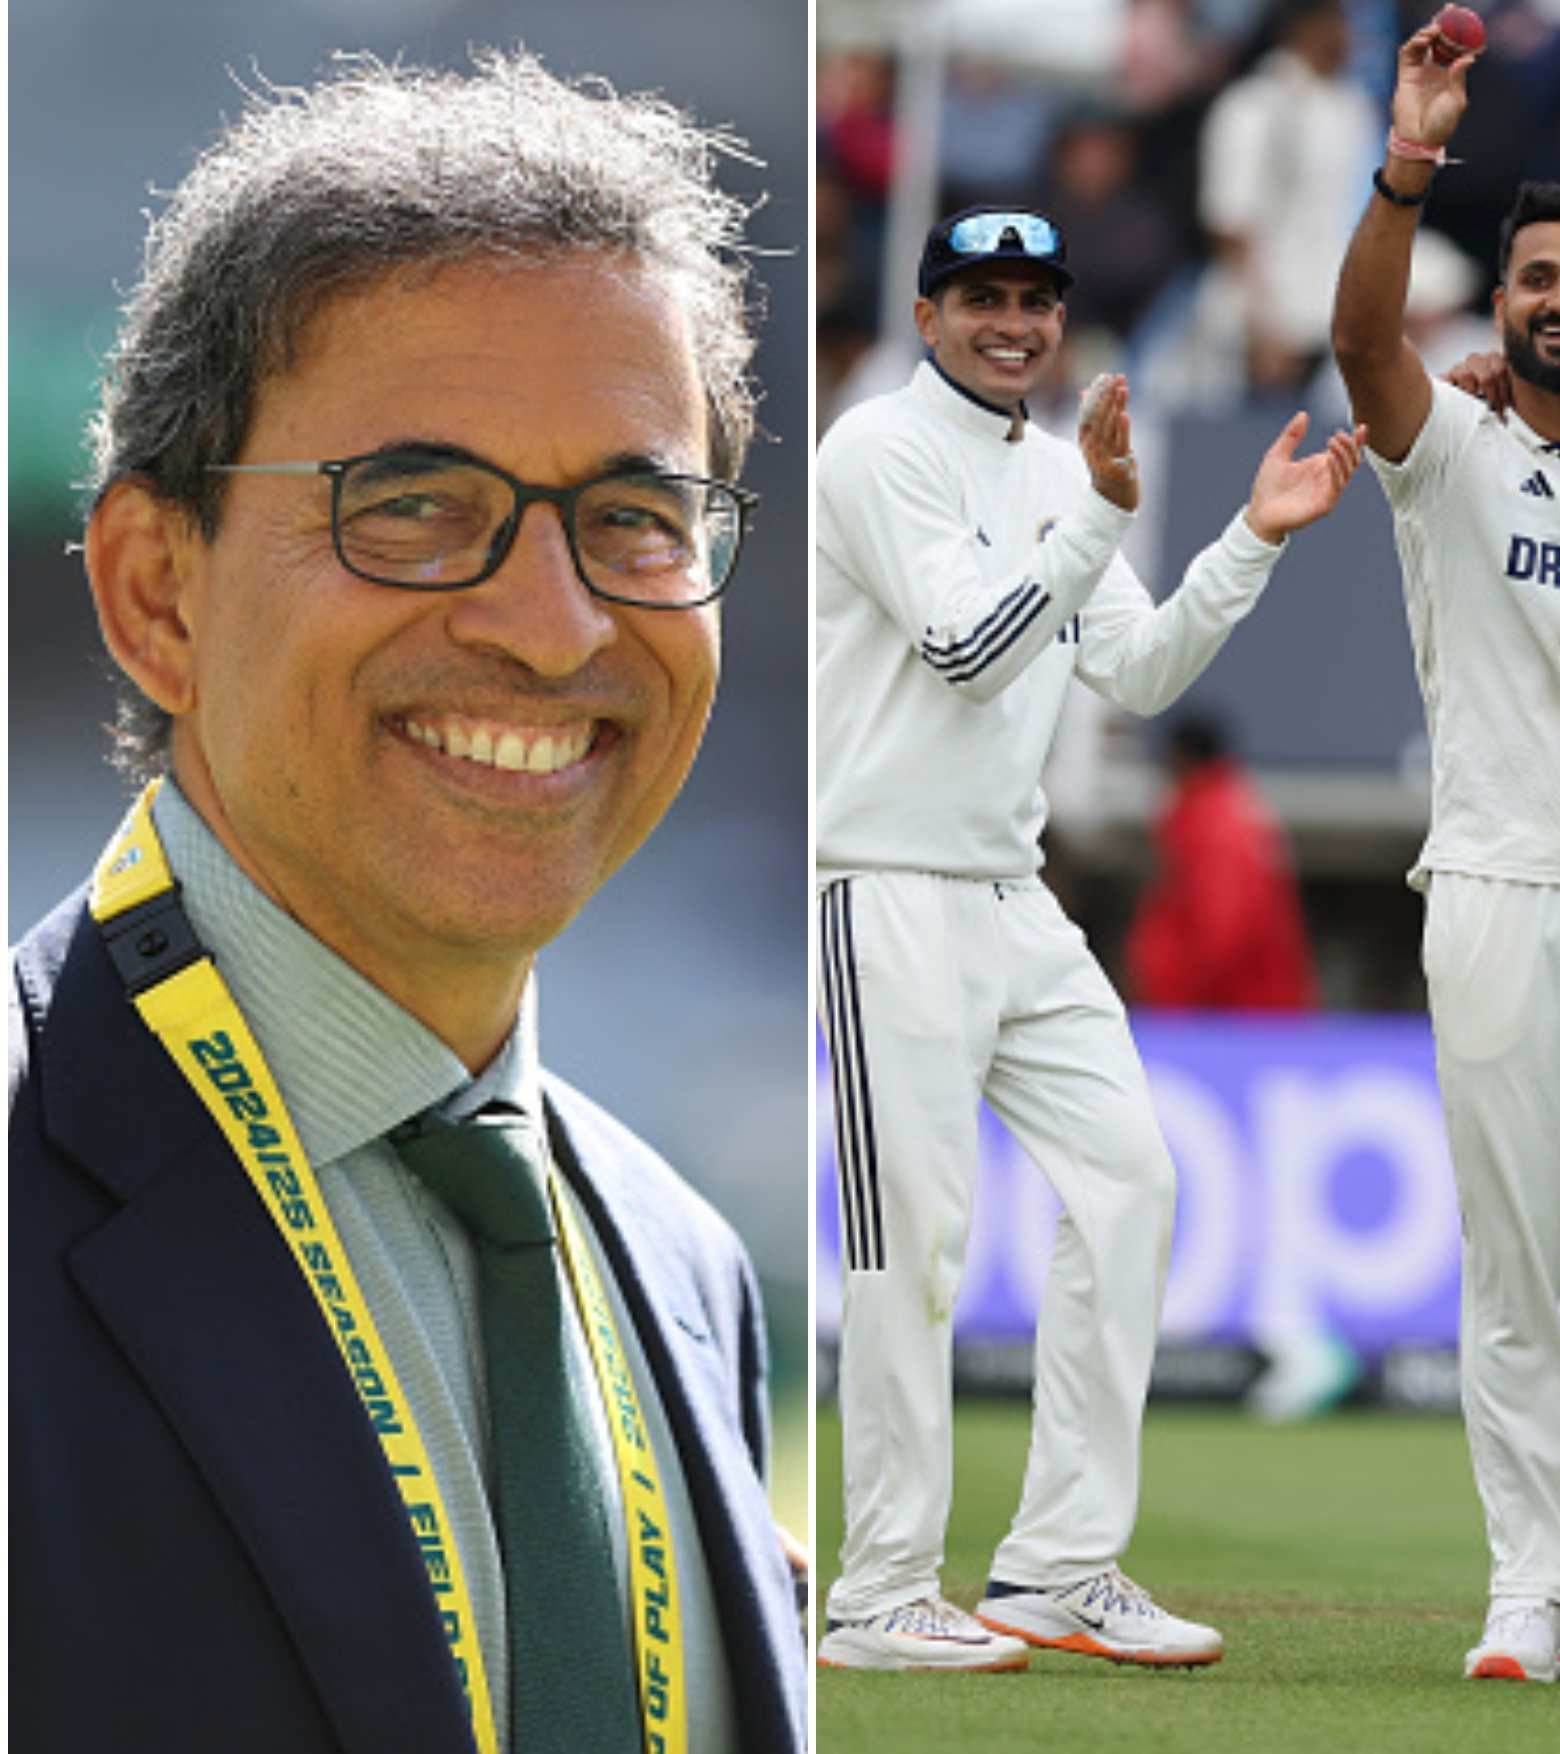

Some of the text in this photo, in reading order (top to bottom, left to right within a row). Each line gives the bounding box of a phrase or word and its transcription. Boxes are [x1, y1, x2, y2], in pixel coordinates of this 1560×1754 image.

[187, 1030, 315, 1231] 2024/25
[299, 1242, 403, 1434] SEASON
[636, 1506, 670, 1643] PLAY
